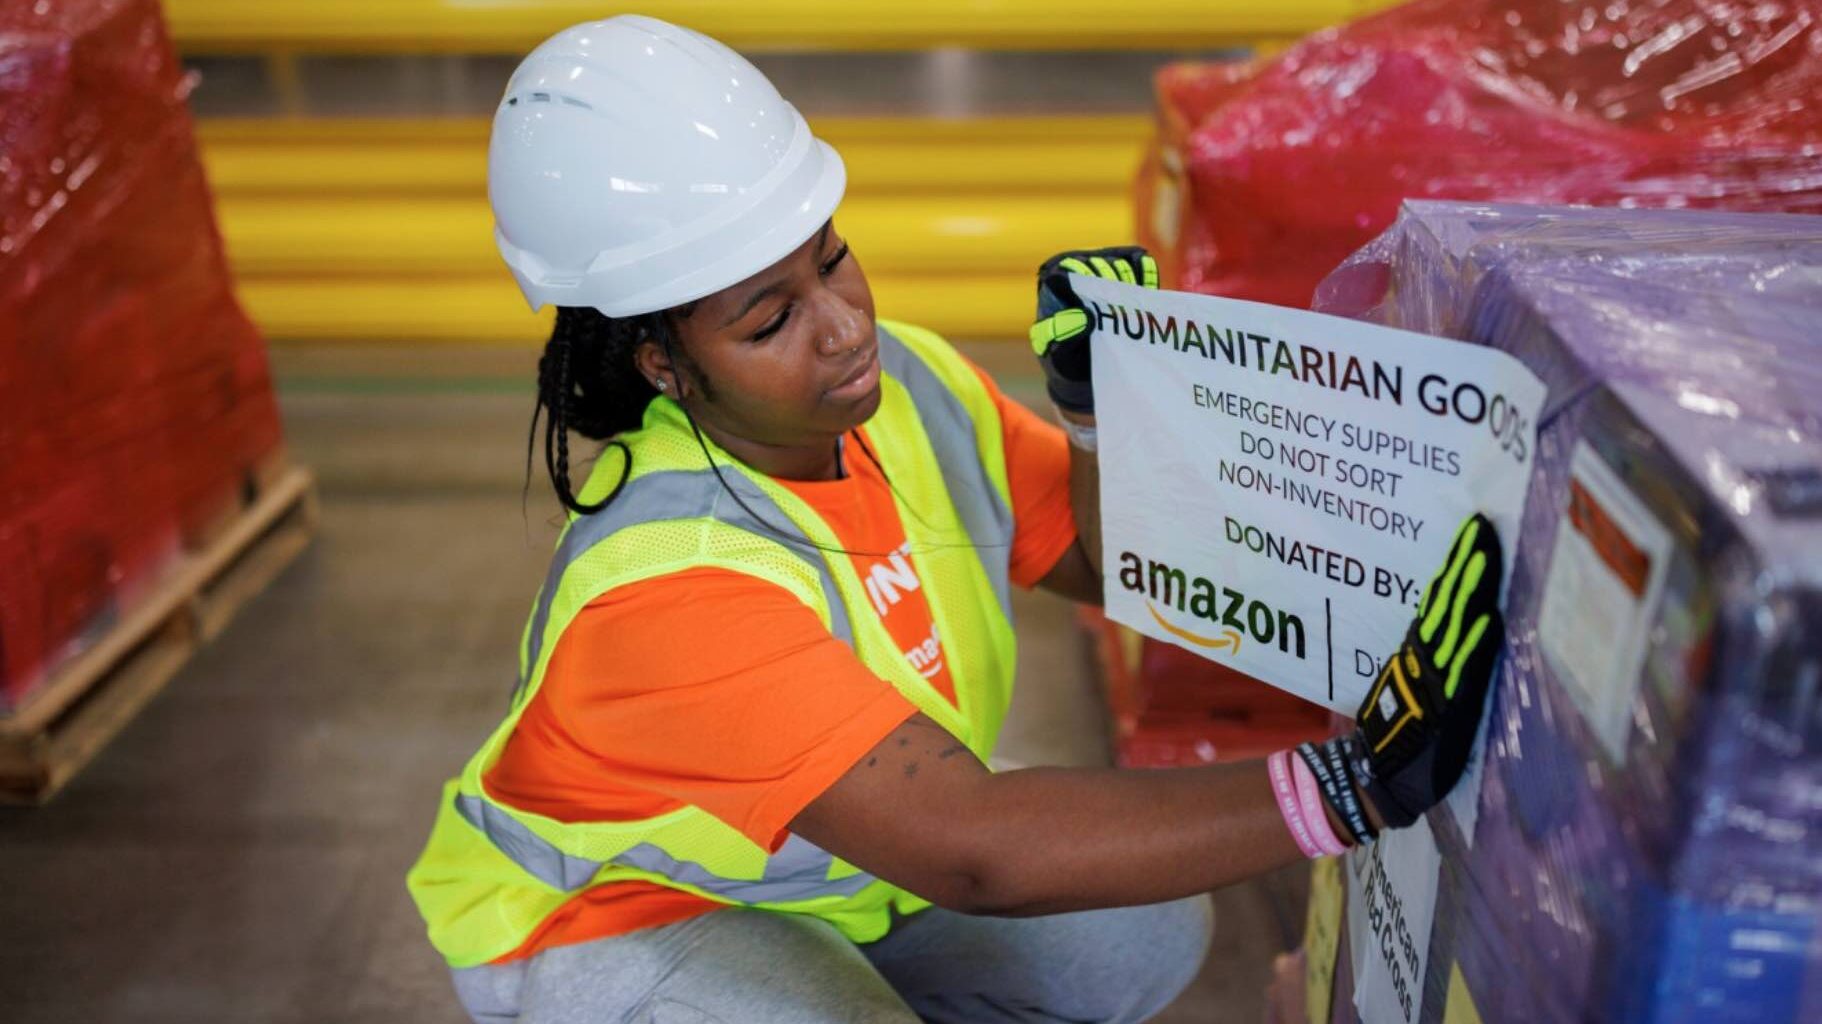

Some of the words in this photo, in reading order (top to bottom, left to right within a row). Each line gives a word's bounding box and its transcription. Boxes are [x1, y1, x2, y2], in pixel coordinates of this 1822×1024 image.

[1091, 301, 1402, 405] HUMANITARIAN
[1417, 374, 1527, 463] GOODS
[1193, 383, 1336, 443] EMERGENCY
[1341, 423, 1461, 477] SUPPLIES
[1240, 431, 1275, 461] DO
[1280, 443, 1330, 479] NOT
[1336, 459, 1403, 498] SORT
[1219, 459, 1424, 542] NON-INVENTORY
[1119, 551, 1306, 660] amazon
[1224, 516, 1366, 588] DONATED
[1373, 566, 1421, 609] BY:
[1381, 922, 1413, 1023] Cross
